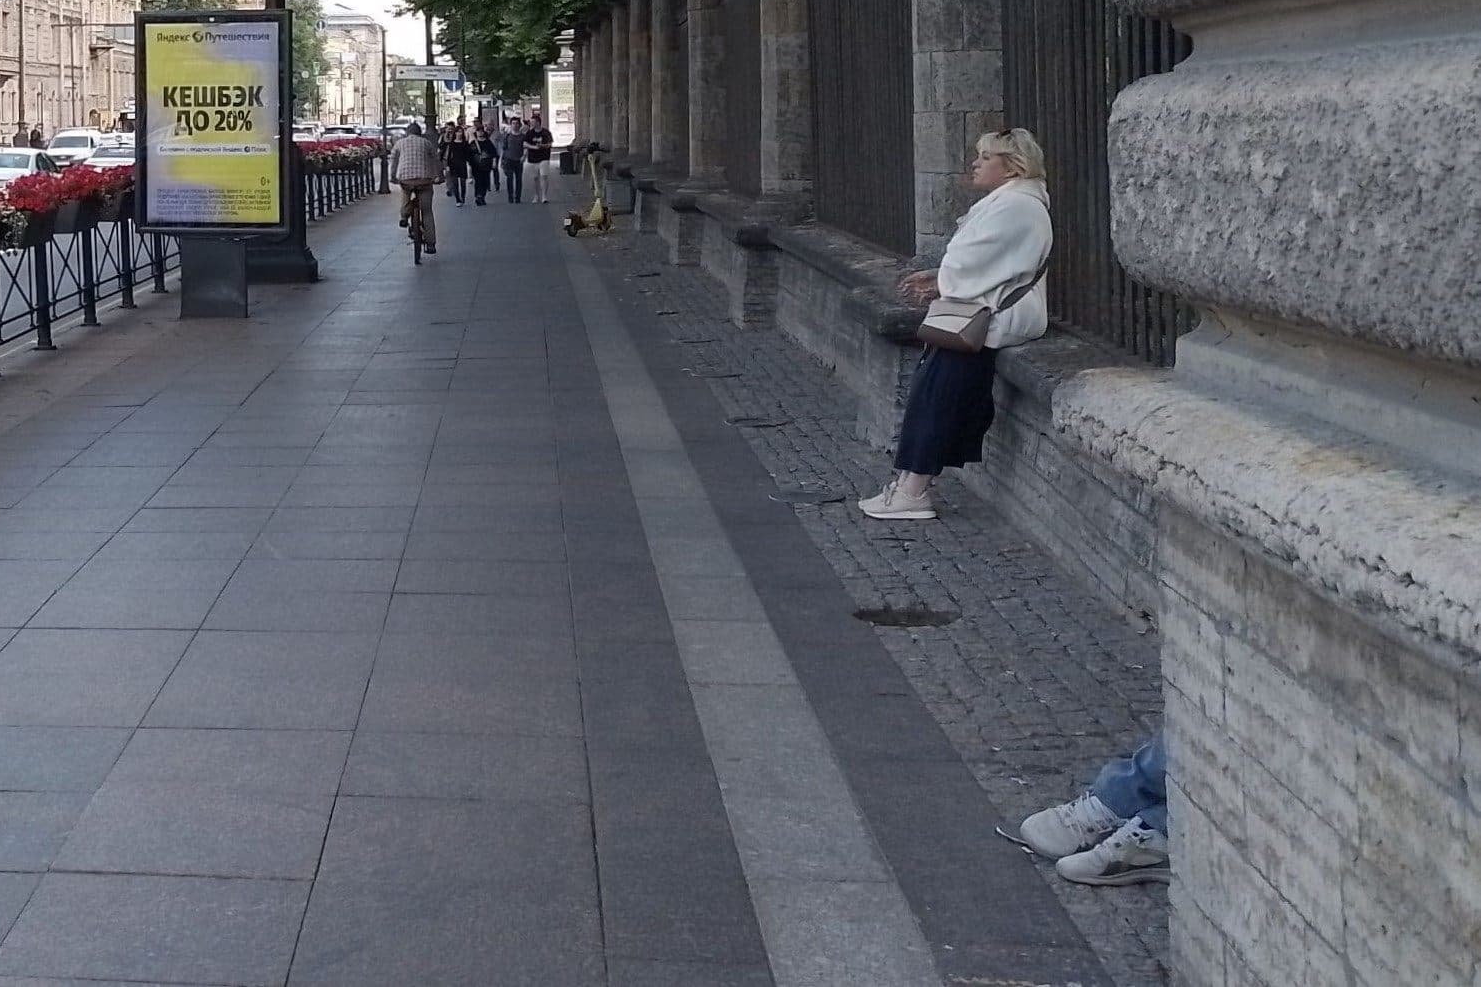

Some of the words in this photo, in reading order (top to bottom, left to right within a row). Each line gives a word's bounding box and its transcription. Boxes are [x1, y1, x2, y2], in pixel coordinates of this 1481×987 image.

[157, 32, 191, 44] Яндекс
[204, 31, 270, 44] Путешествия
[163, 85, 264, 108] КЕШБЭК
[174, 109, 210, 136] ДО
[214, 109, 253, 132] 20%
[260, 176, 270, 186] 0+
